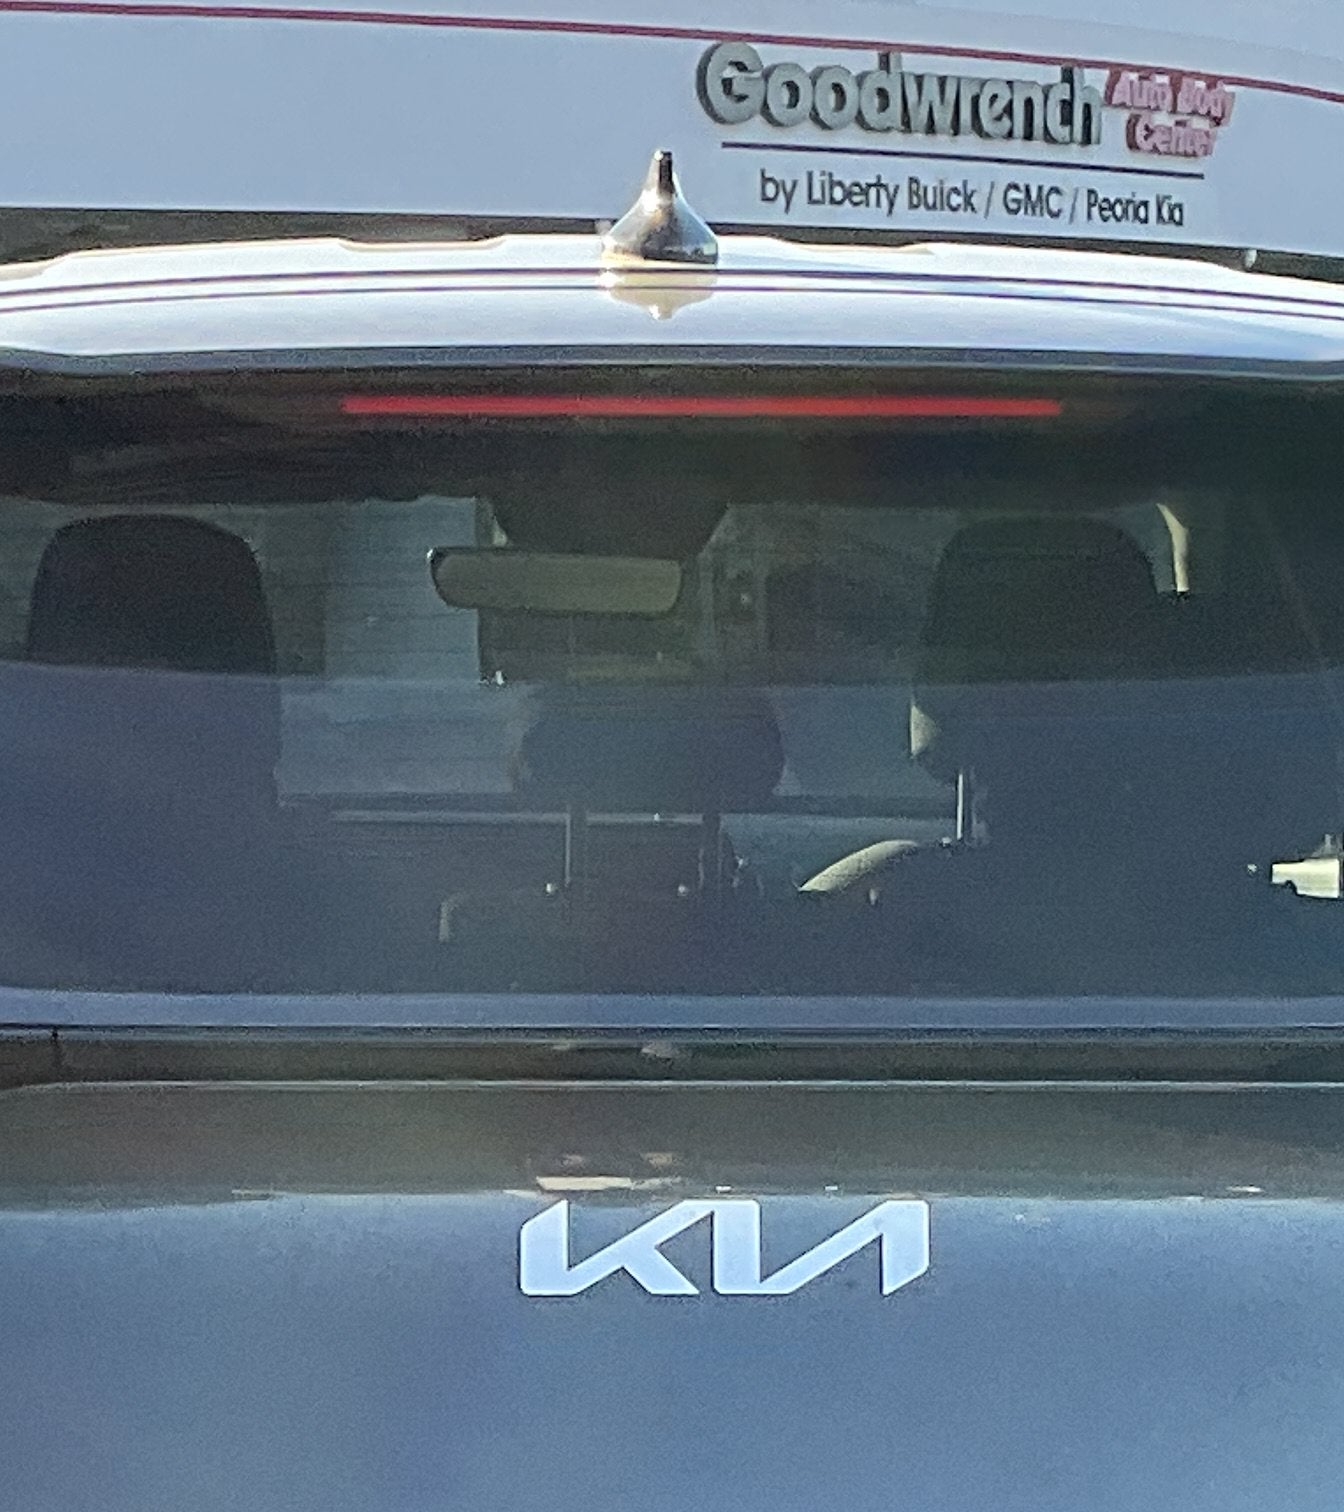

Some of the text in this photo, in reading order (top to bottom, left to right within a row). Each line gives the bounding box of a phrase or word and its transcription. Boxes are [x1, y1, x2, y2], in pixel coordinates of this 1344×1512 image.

[696, 40, 1103, 146] Goodwrench
[759, 168, 797, 214] by
[806, 170, 900, 216] Liberty
[907, 176, 977, 213] Buick
[1002, 182, 1063, 219] GMC
[1086, 188, 1150, 225] Peoria
[1155, 194, 1184, 227] Kia
[520, 1199, 930, 1297] KIA
